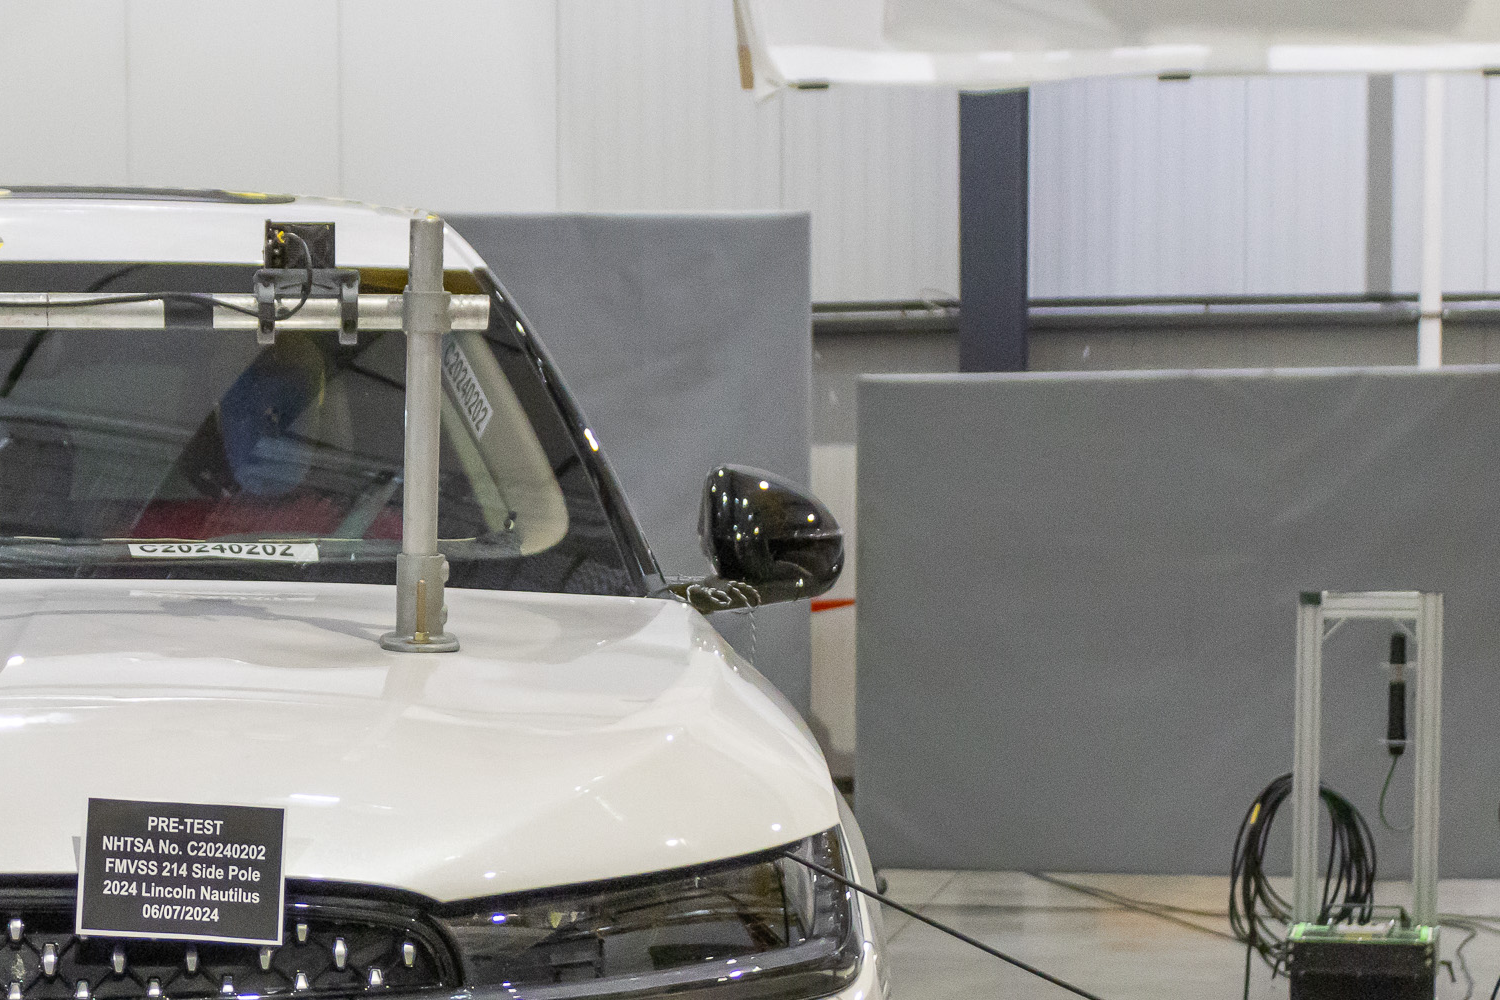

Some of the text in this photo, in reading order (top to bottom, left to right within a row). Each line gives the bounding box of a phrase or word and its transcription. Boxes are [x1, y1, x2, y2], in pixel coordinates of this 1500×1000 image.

[444, 341, 489, 432] C20240202
[138, 543, 295, 557] C20240202
[147, 816, 224, 836] PRE-TEST
[102, 835, 266, 861] NHTSA No. C20240202
[105, 857, 261, 882] FMVSS 214 Side Pole
[102, 879, 260, 904] 2024 Lincoln Nautilus
[142, 903, 220, 922] 06/07/2024
